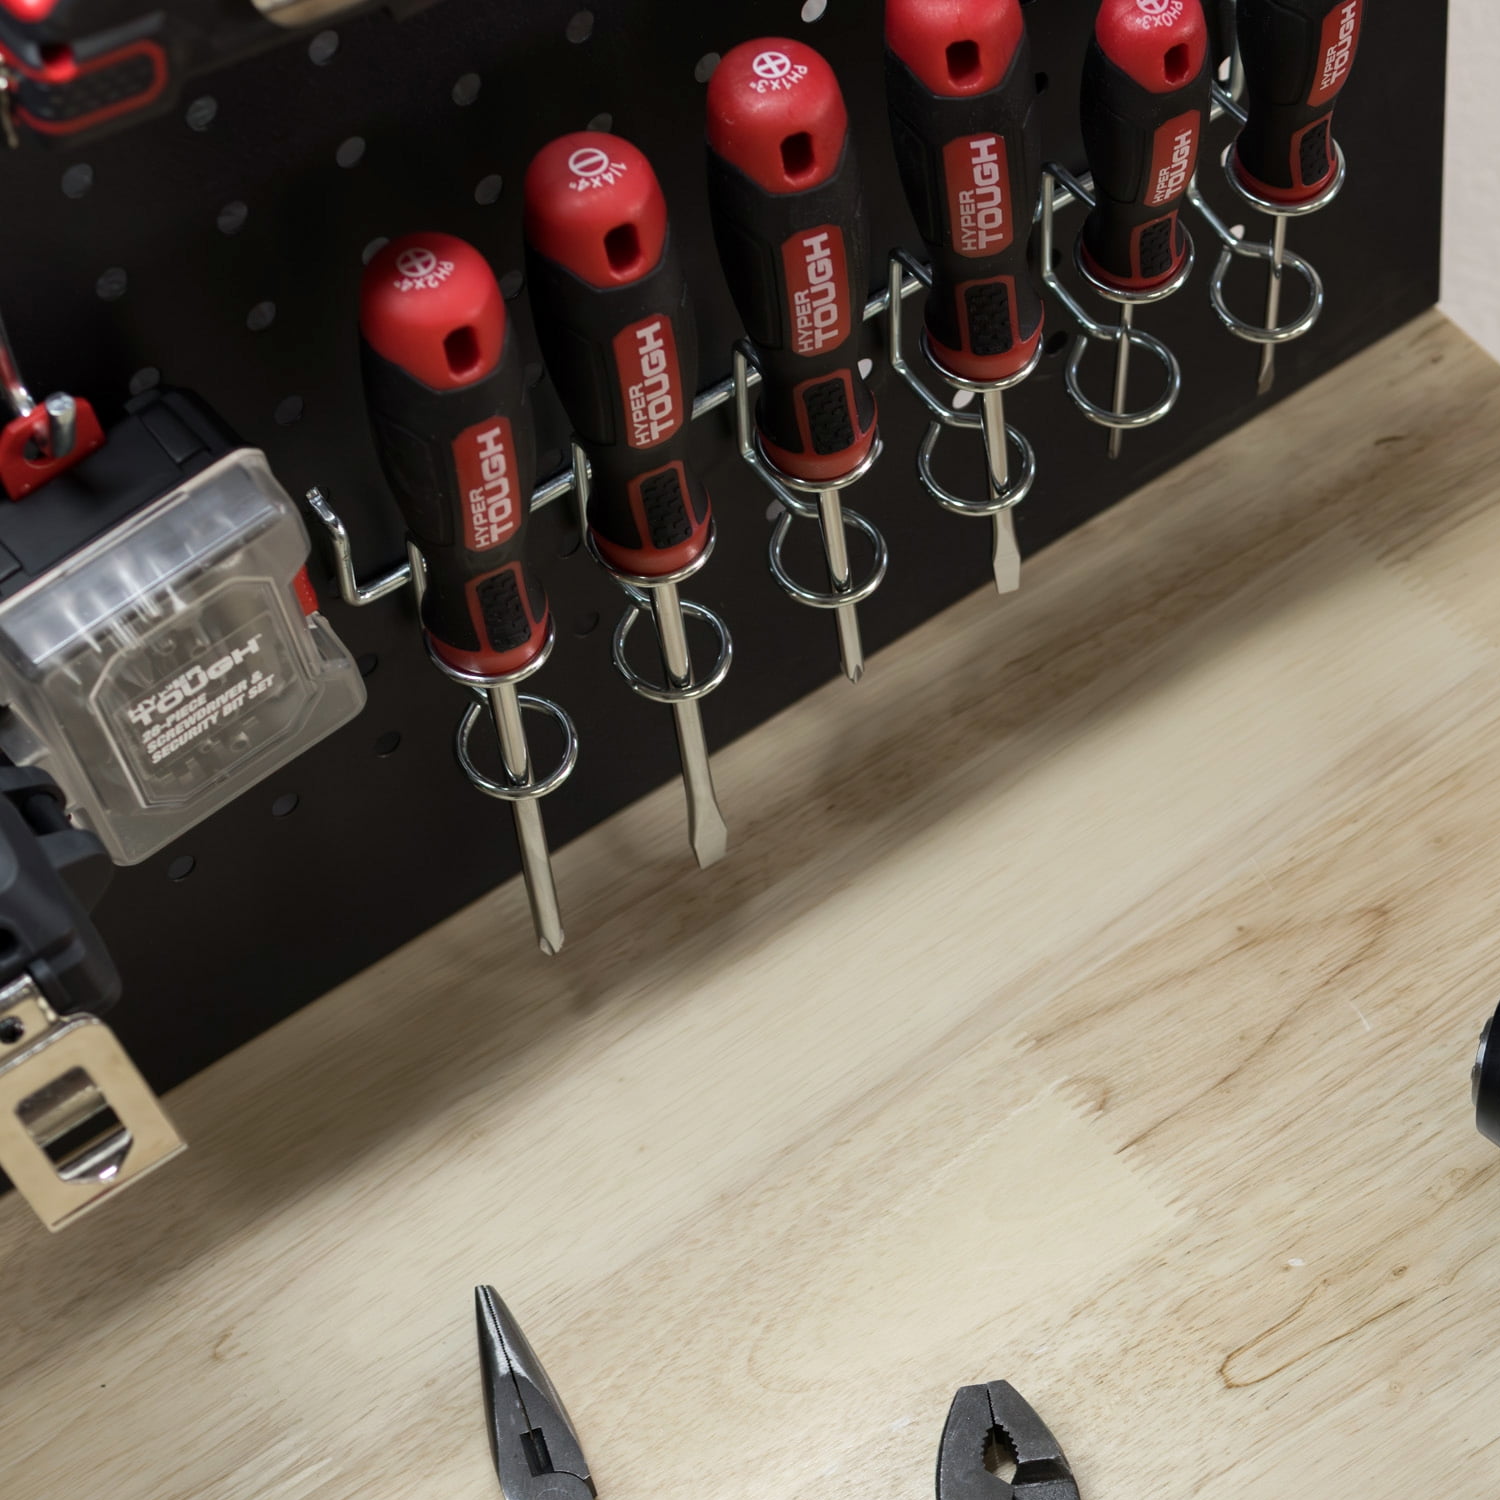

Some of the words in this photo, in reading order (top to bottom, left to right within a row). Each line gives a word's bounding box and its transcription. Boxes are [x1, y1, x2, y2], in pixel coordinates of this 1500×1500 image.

[1319, 44, 1338, 91] HYPER
[1329, 0, 1357, 85] TOUGH
[969, 137, 1003, 250] TOUGH
[1151, 166, 1171, 204] HYPER
[1163, 129, 1193, 200] TOUGH
[958, 189, 977, 251] HYPER
[793, 289, 814, 353] HYPER
[802, 232, 839, 349] TOUGH
[628, 382, 651, 446] HYPER
[635, 321, 674, 441] TOUGH
[468, 486, 491, 549] HYPER
[476, 427, 514, 544] TOUGH
[129, 636, 261, 727] TOUGH
[146, 679, 249, 754] SCREWDRIVER
[250, 670, 264, 685] &
[151, 711, 220, 765] SECURITY
[222, 692, 246, 718] BIT
[247, 673, 275, 699] SET
